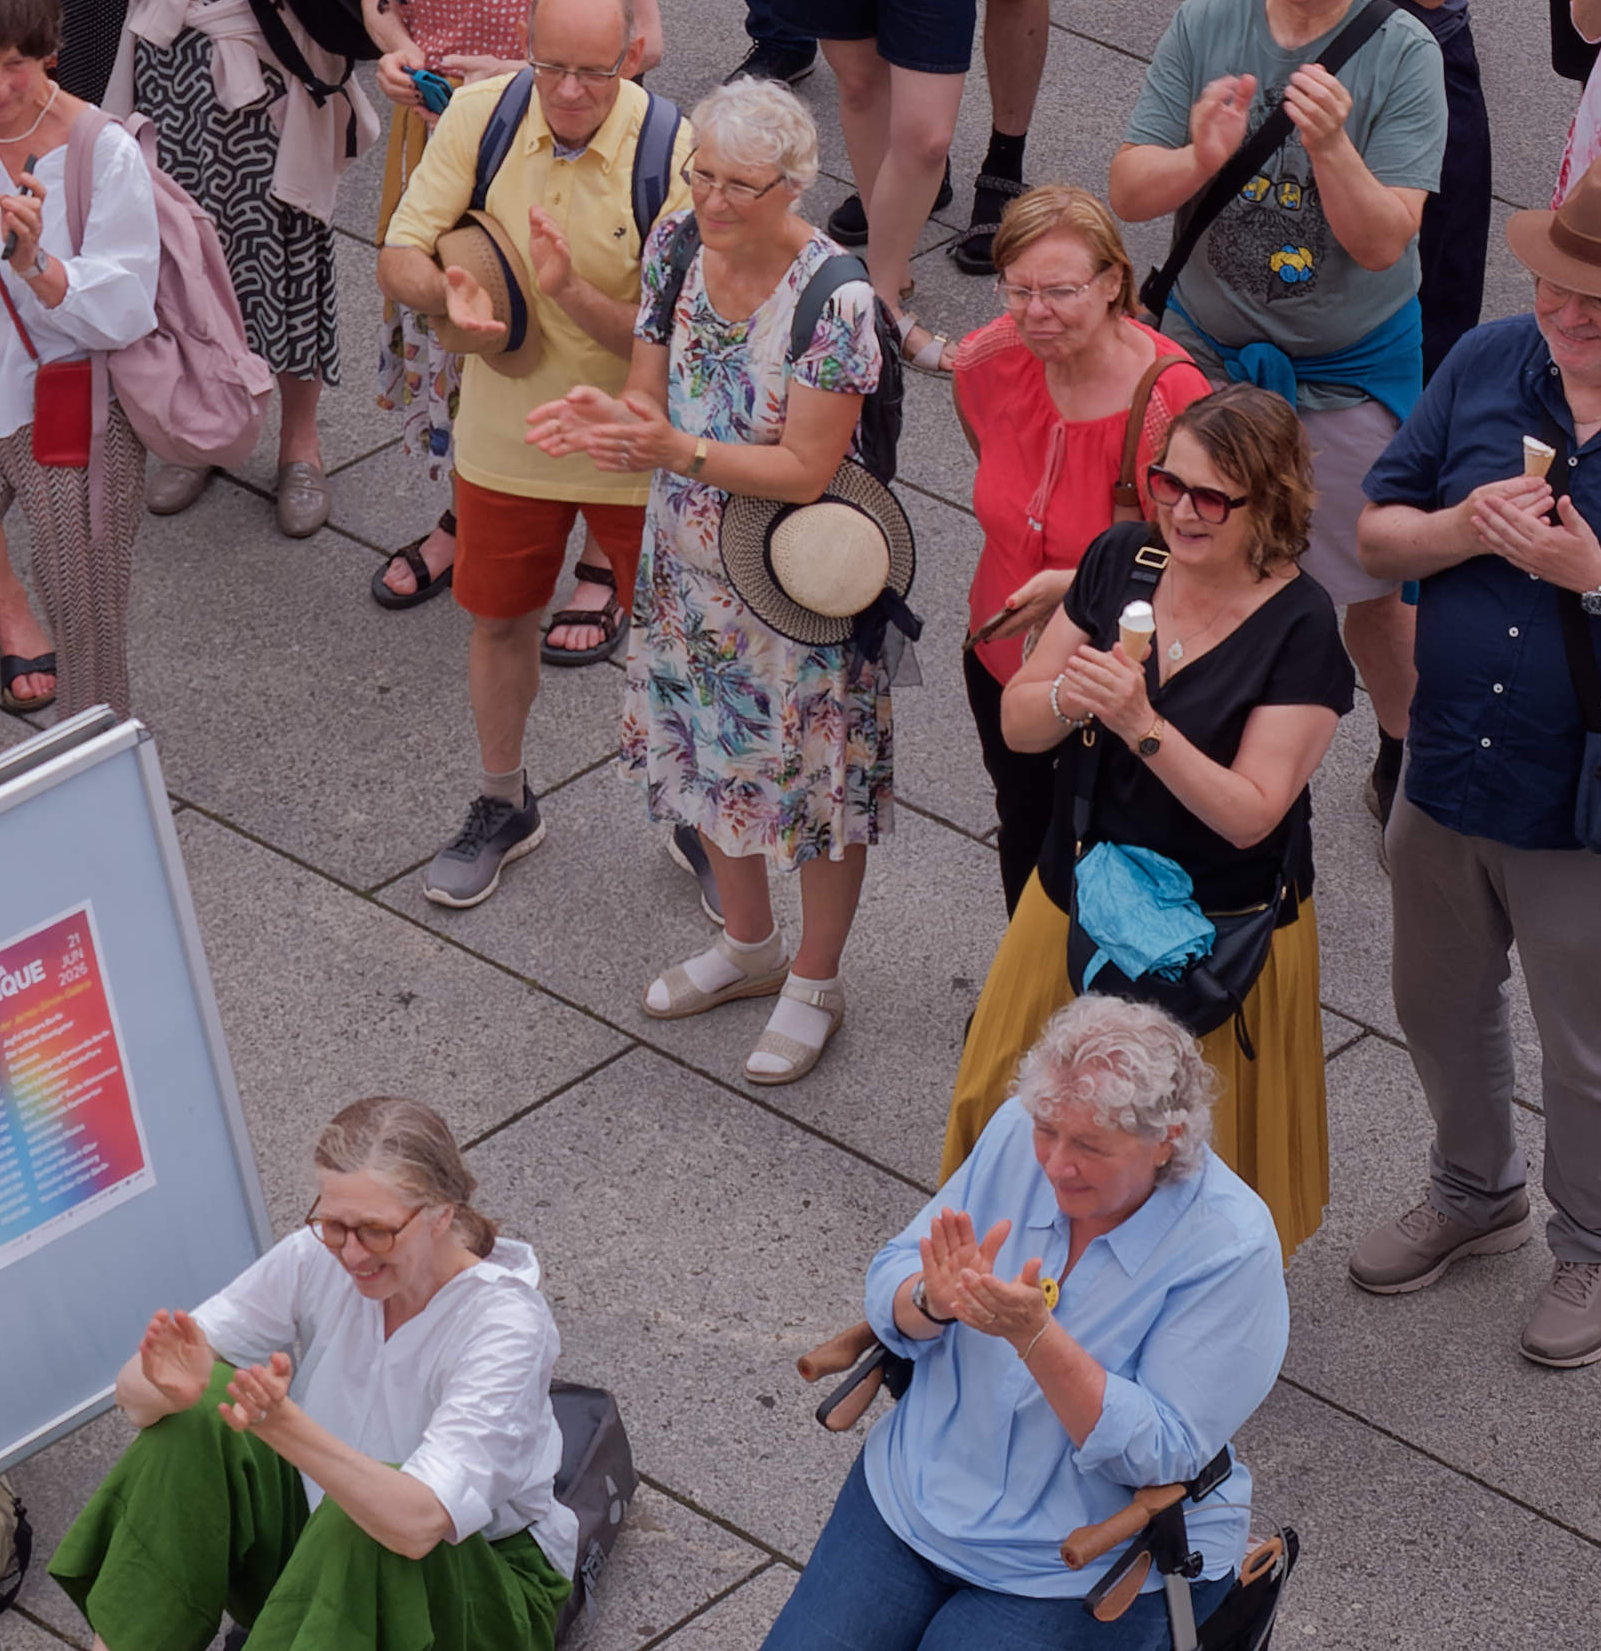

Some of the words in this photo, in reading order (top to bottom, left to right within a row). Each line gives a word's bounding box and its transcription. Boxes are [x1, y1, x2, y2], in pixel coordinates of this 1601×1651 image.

[67, 931, 80, 948] 21
[59, 946, 84, 970] JUN
[57, 960, 88, 987] 2026
